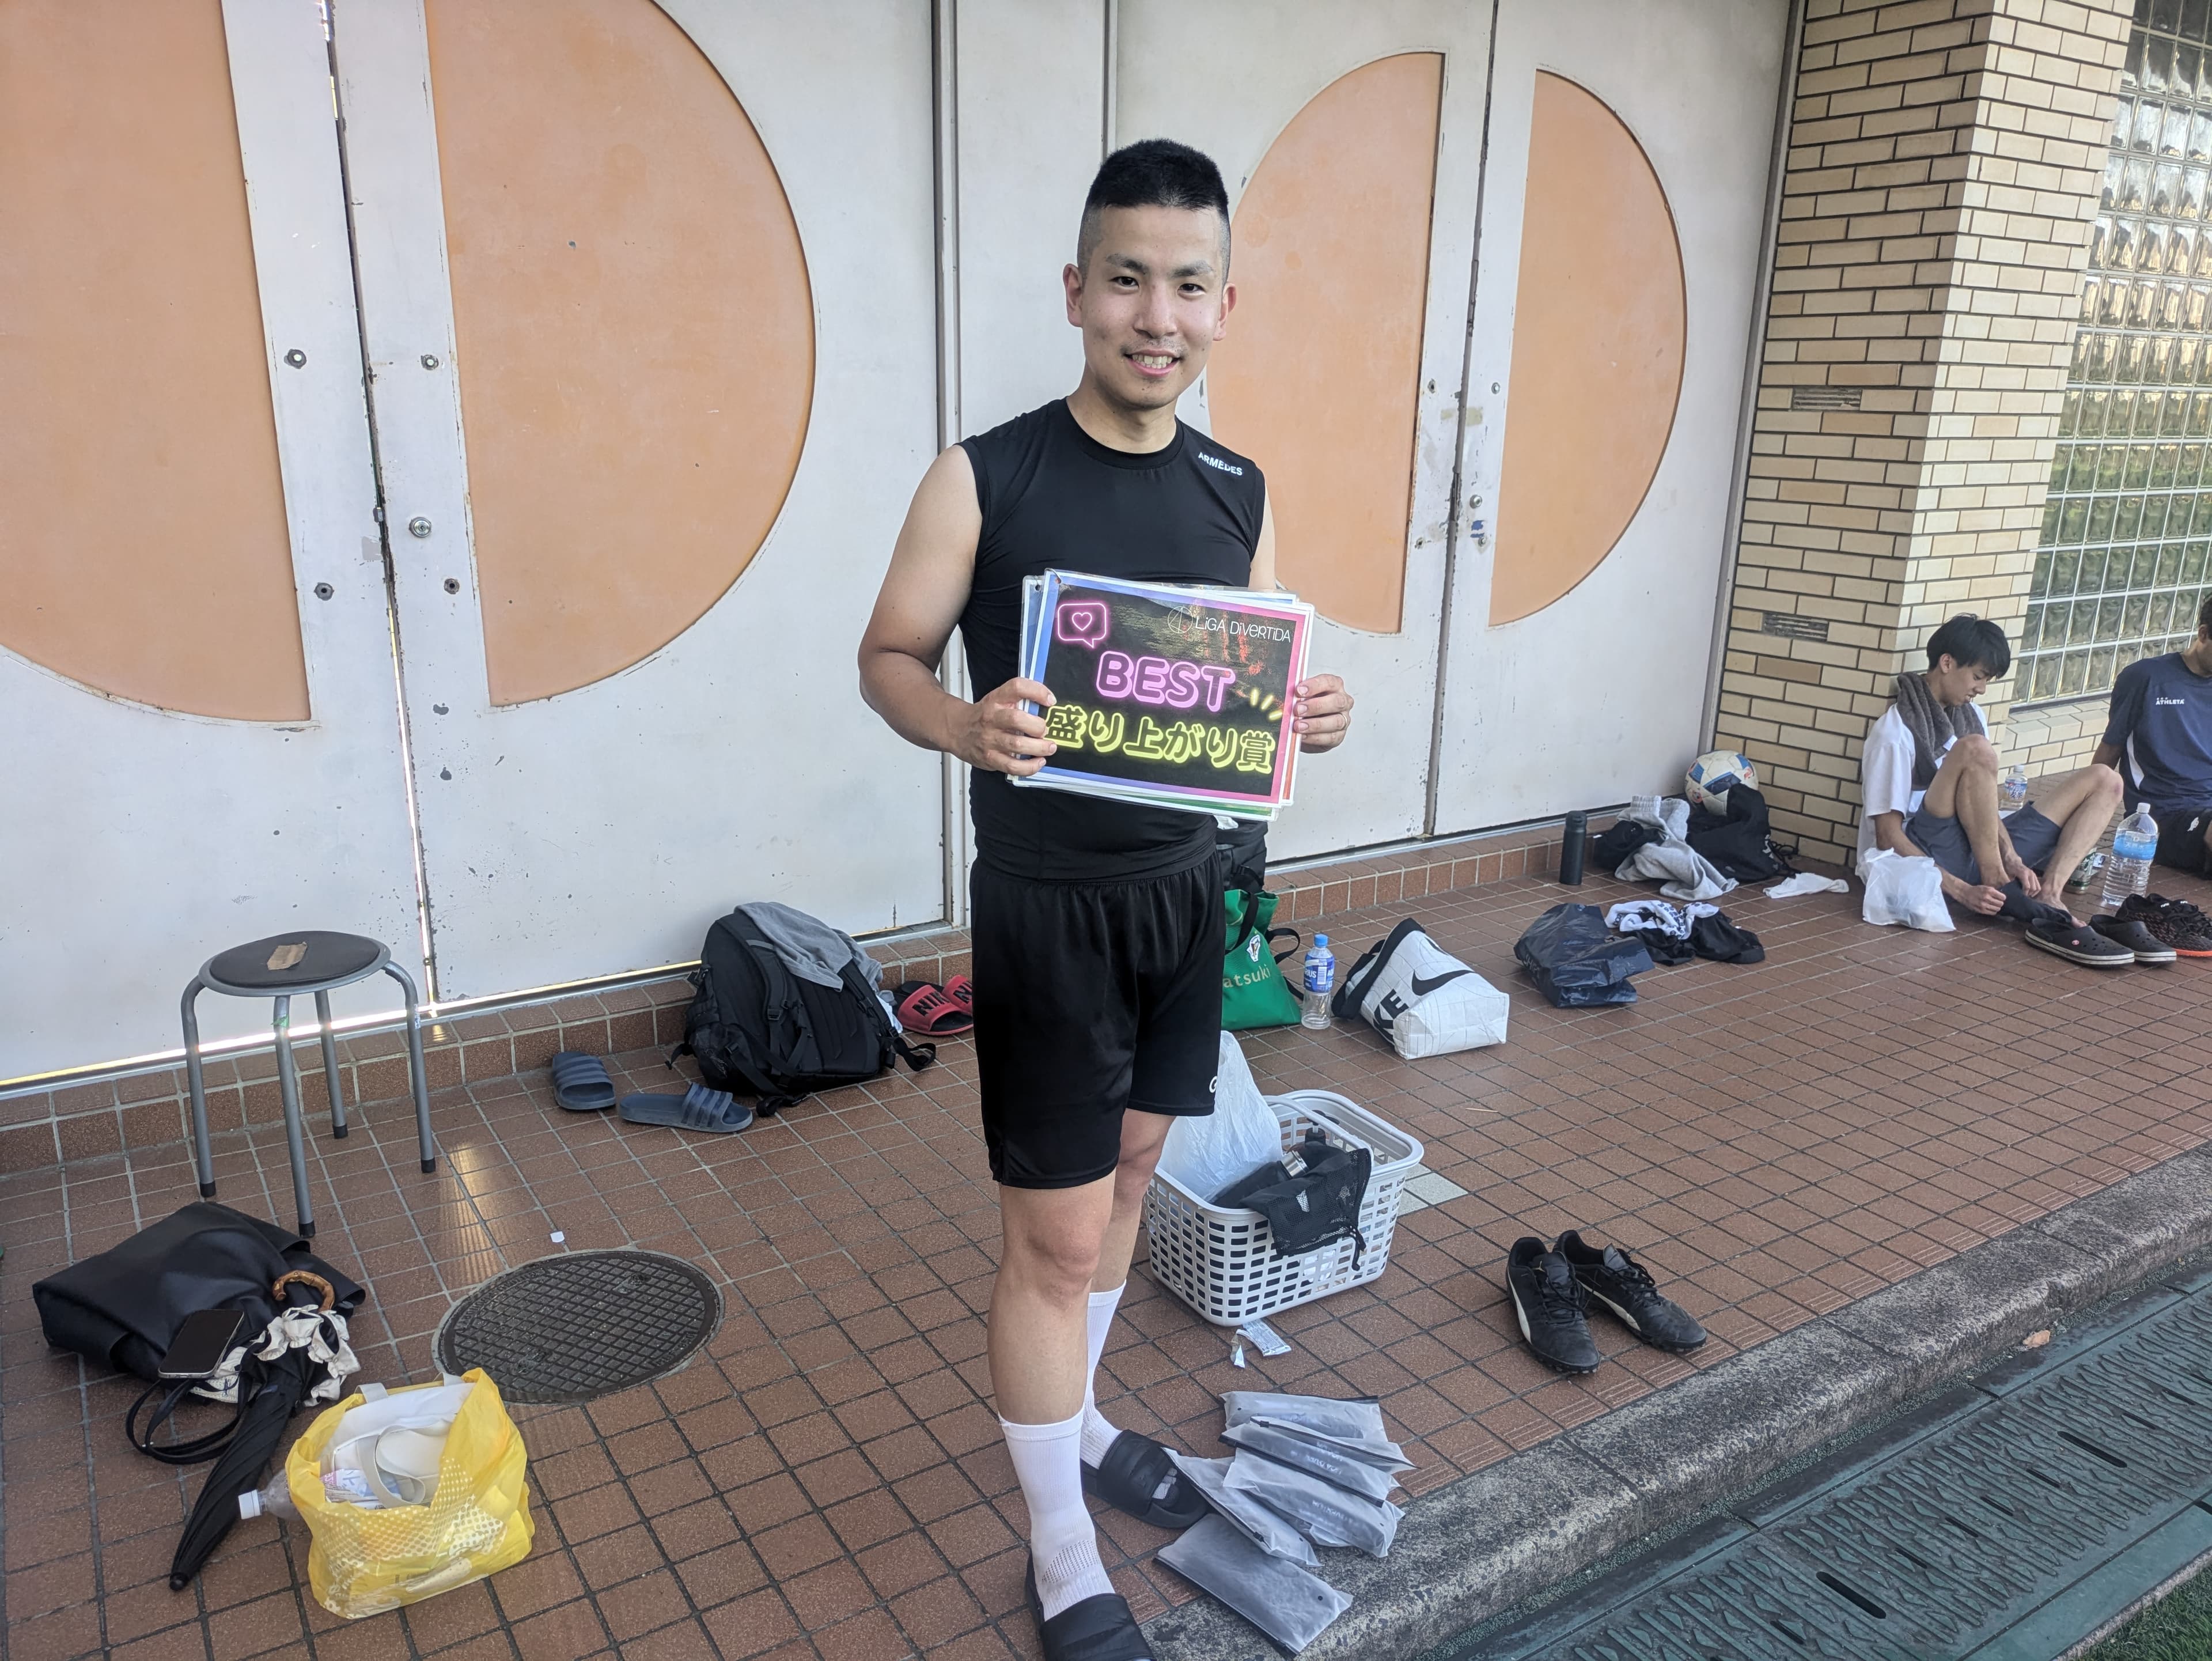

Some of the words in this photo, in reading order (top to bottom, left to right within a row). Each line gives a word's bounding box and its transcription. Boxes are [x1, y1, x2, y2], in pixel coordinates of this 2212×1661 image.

[1198, 451, 1243, 476] ARMEDES
[1096, 650, 1237, 713] BEST
[2155, 697, 2185, 705] ATHLETA
[1044, 704, 1277, 774] 盛り上がり賞
